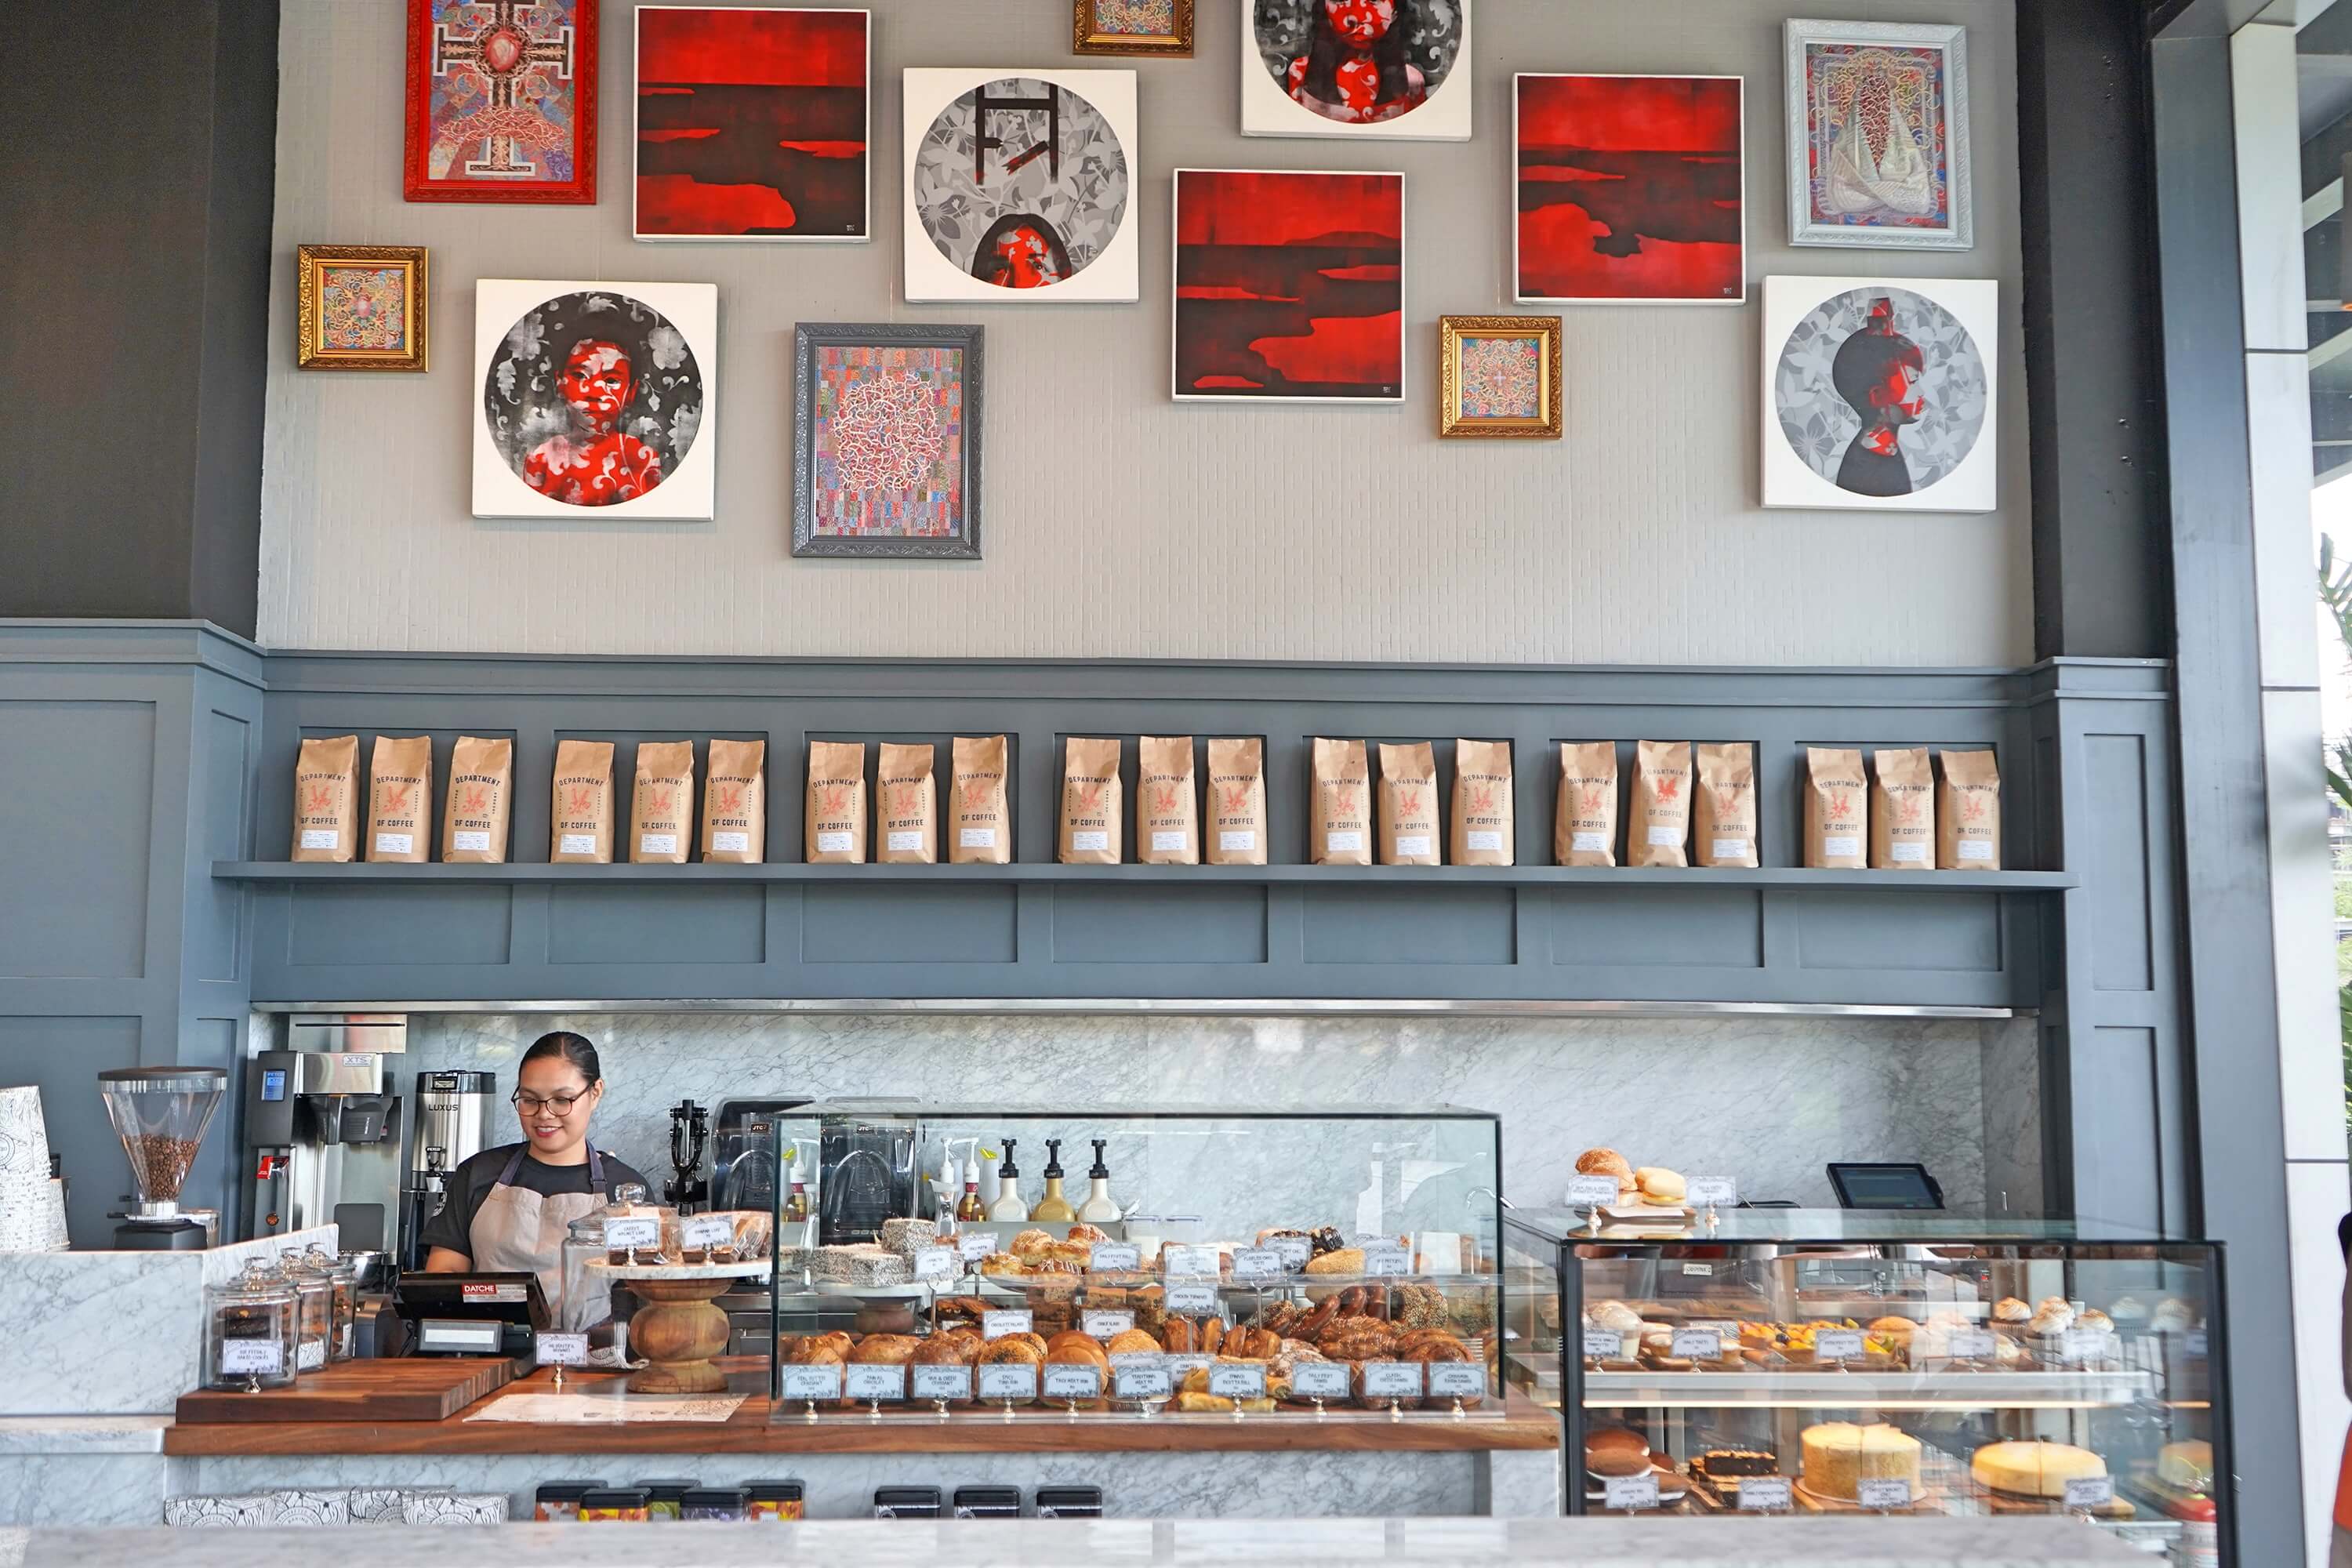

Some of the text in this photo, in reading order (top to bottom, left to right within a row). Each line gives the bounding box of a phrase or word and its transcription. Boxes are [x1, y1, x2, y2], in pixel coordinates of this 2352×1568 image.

[301, 774, 346, 782] DEPARTMENT
[456, 776, 501, 786] DEPARTMENT
[711, 776, 755, 785] DEPARTMENT
[883, 778, 925, 786] DEPARTMENT
[959, 773, 1004, 782] DEPARTMENT
[1145, 775, 1189, 785] DEPARTMENT
[1464, 775, 1508, 784] DEPARTMENT
[559, 778, 604, 787] DEPARTMENT
[814, 779, 858, 788] DEPARTMENT
[1323, 779, 1364, 787] DEPARTMENT
[1568, 778, 1613, 787] DEPARTMENT
